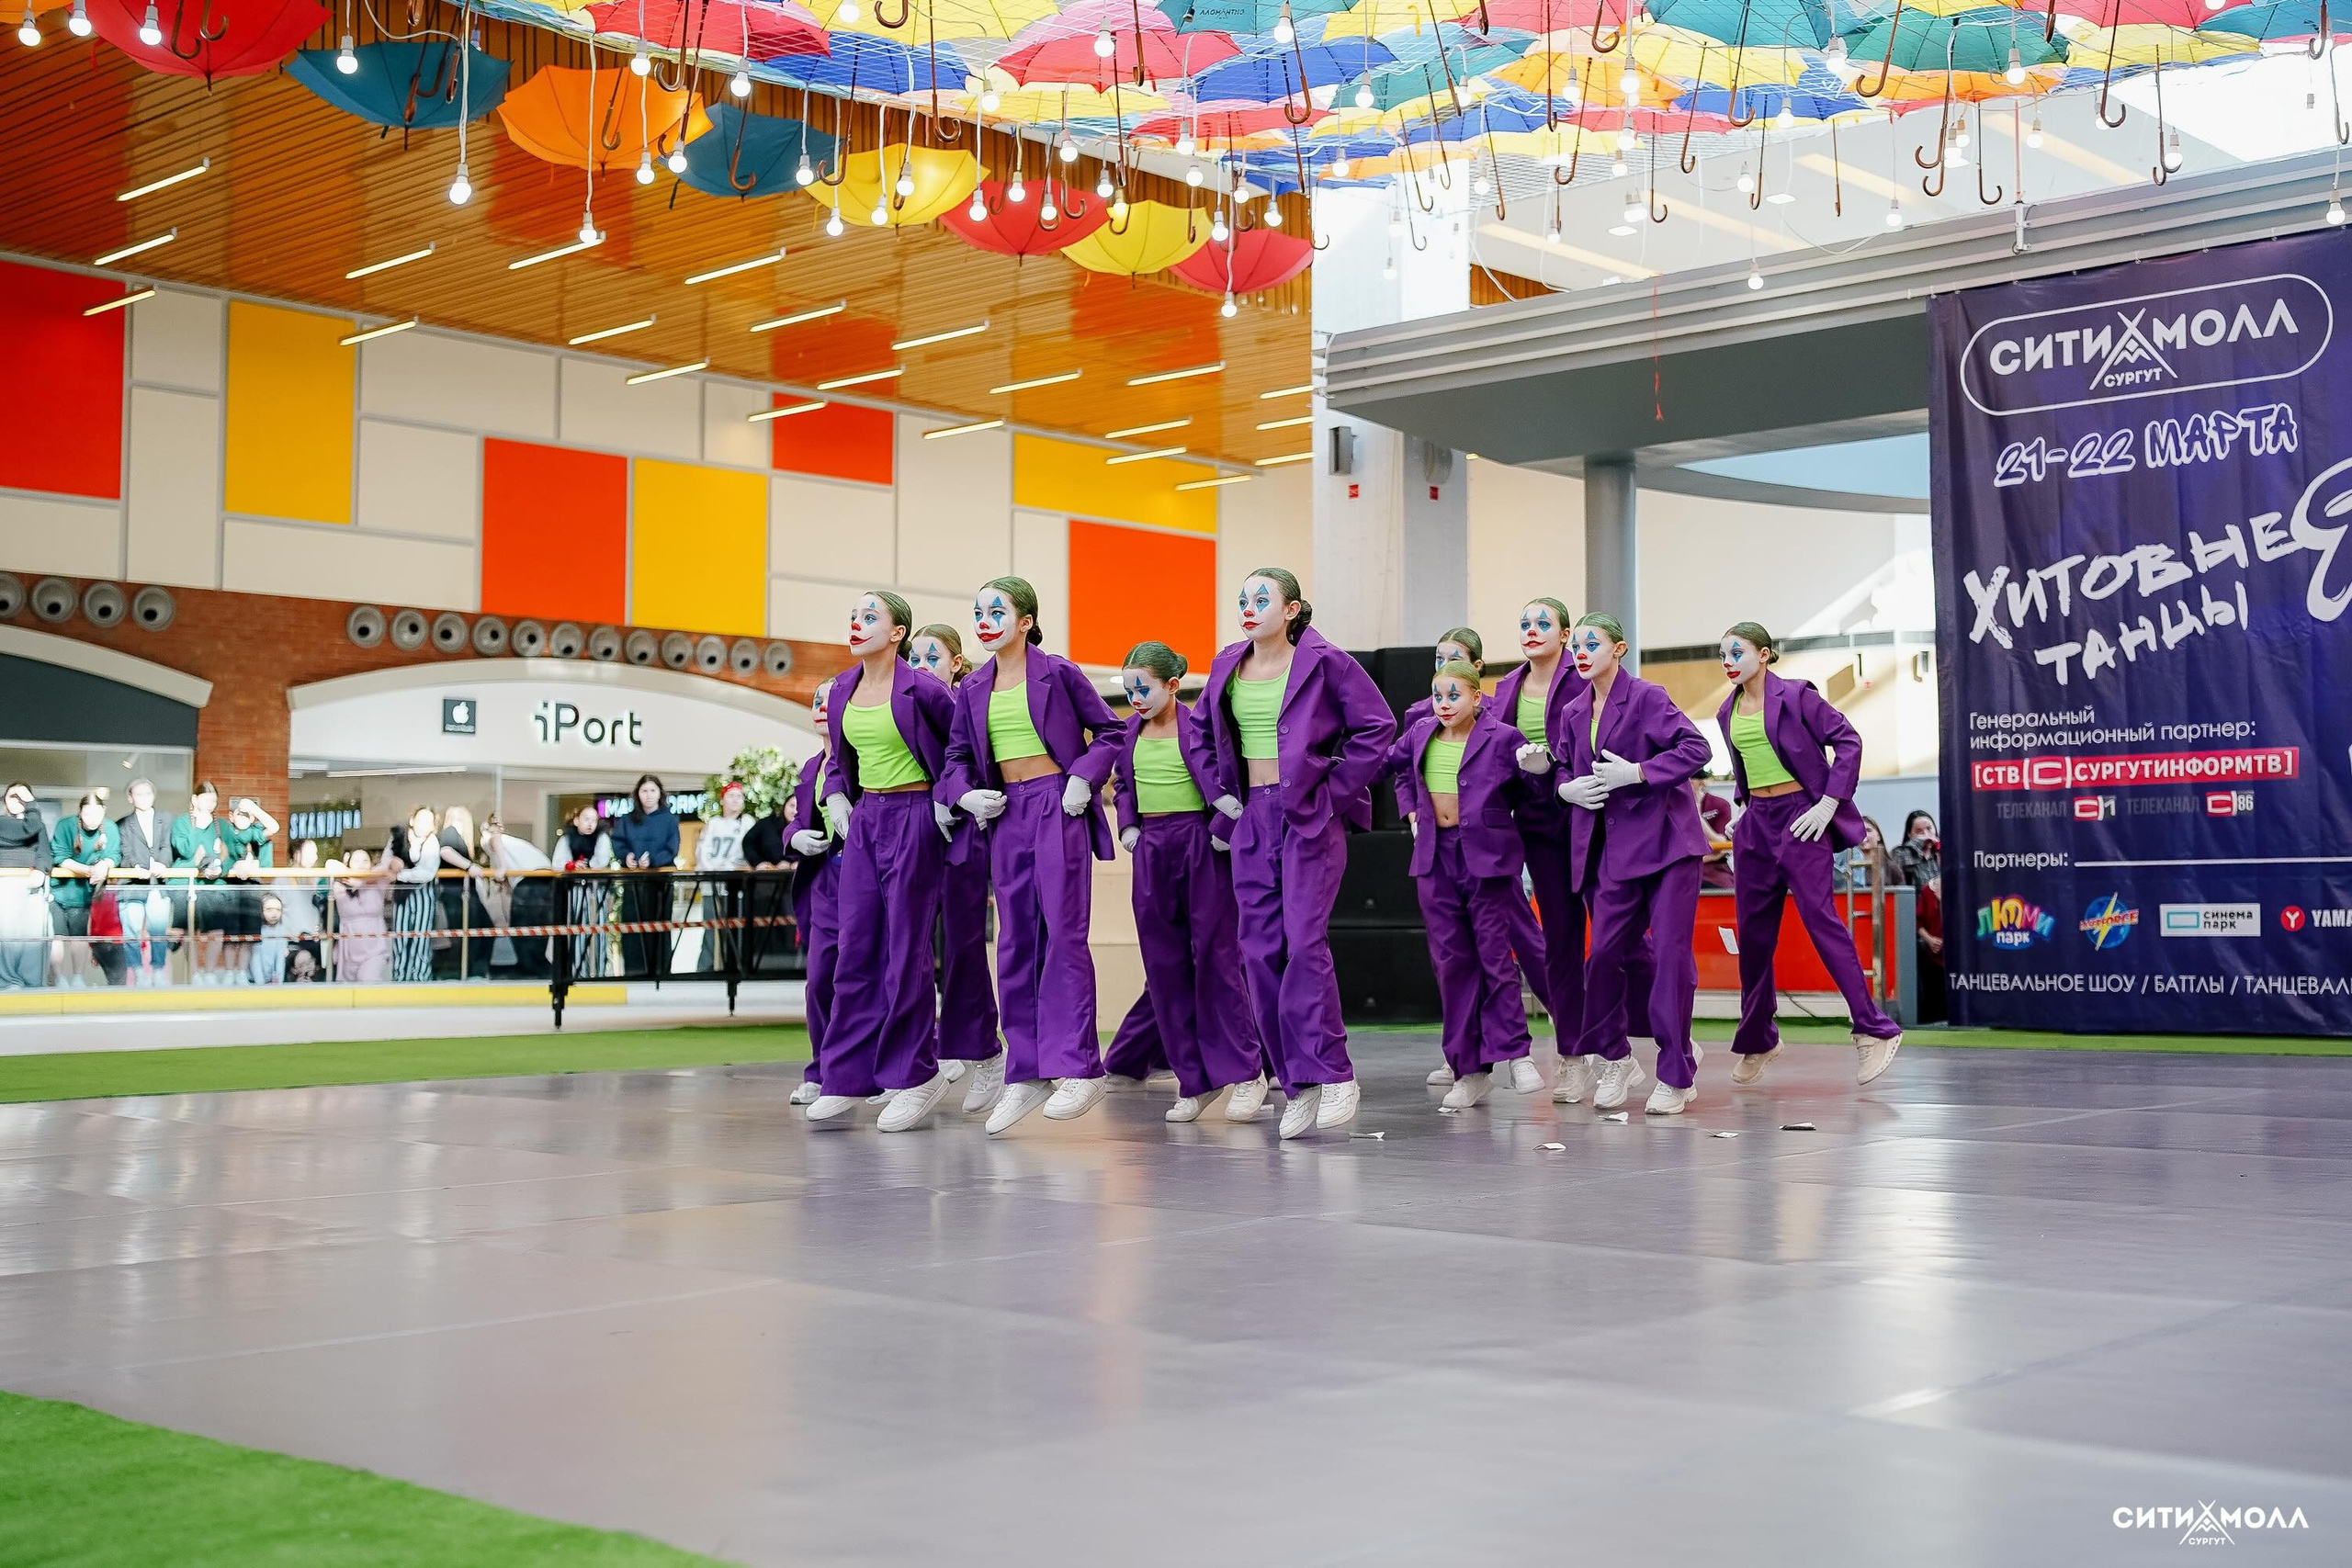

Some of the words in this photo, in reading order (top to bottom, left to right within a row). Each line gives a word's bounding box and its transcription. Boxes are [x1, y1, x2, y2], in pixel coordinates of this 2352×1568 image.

[1989, 324, 2112, 376] СИТИ
[2152, 298, 2300, 352] МОЛЛ
[2103, 367, 2163, 389] СУРГУТ
[1994, 428, 2136, 488] 21-22
[2143, 402, 2298, 468] МАРТА
[1962, 511, 2296, 649] ХИТОВЫЕ
[2033, 581, 2249, 686] ТАНЦЫ
[534, 702, 642, 746] iPort
[1969, 705, 2095, 731] Генеральный
[1969, 722, 2155, 752] информационный
[2161, 720, 2256, 743] партнер:
[1996, 800, 2067, 819] ТЕЛЕКАНАЛ
[2125, 795, 2200, 816] ТЕЛЕКАНАЛ
[1973, 851, 2068, 871] Партнеры:
[1976, 897, 2056, 939] ЛЮМИ
[2203, 910, 2254, 920] синема
[2203, 919, 2237, 932] парк
[1996, 931, 2030, 946] парк
[1949, 973, 2086, 992] ТАНЦЕВАЛЬНОЕ
[2088, 974, 2136, 992] ШОУ
[2154, 975, 2224, 994] БАТТЛЫ
[2244, 976, 2352, 997] ТАНЦЕВАЛ
